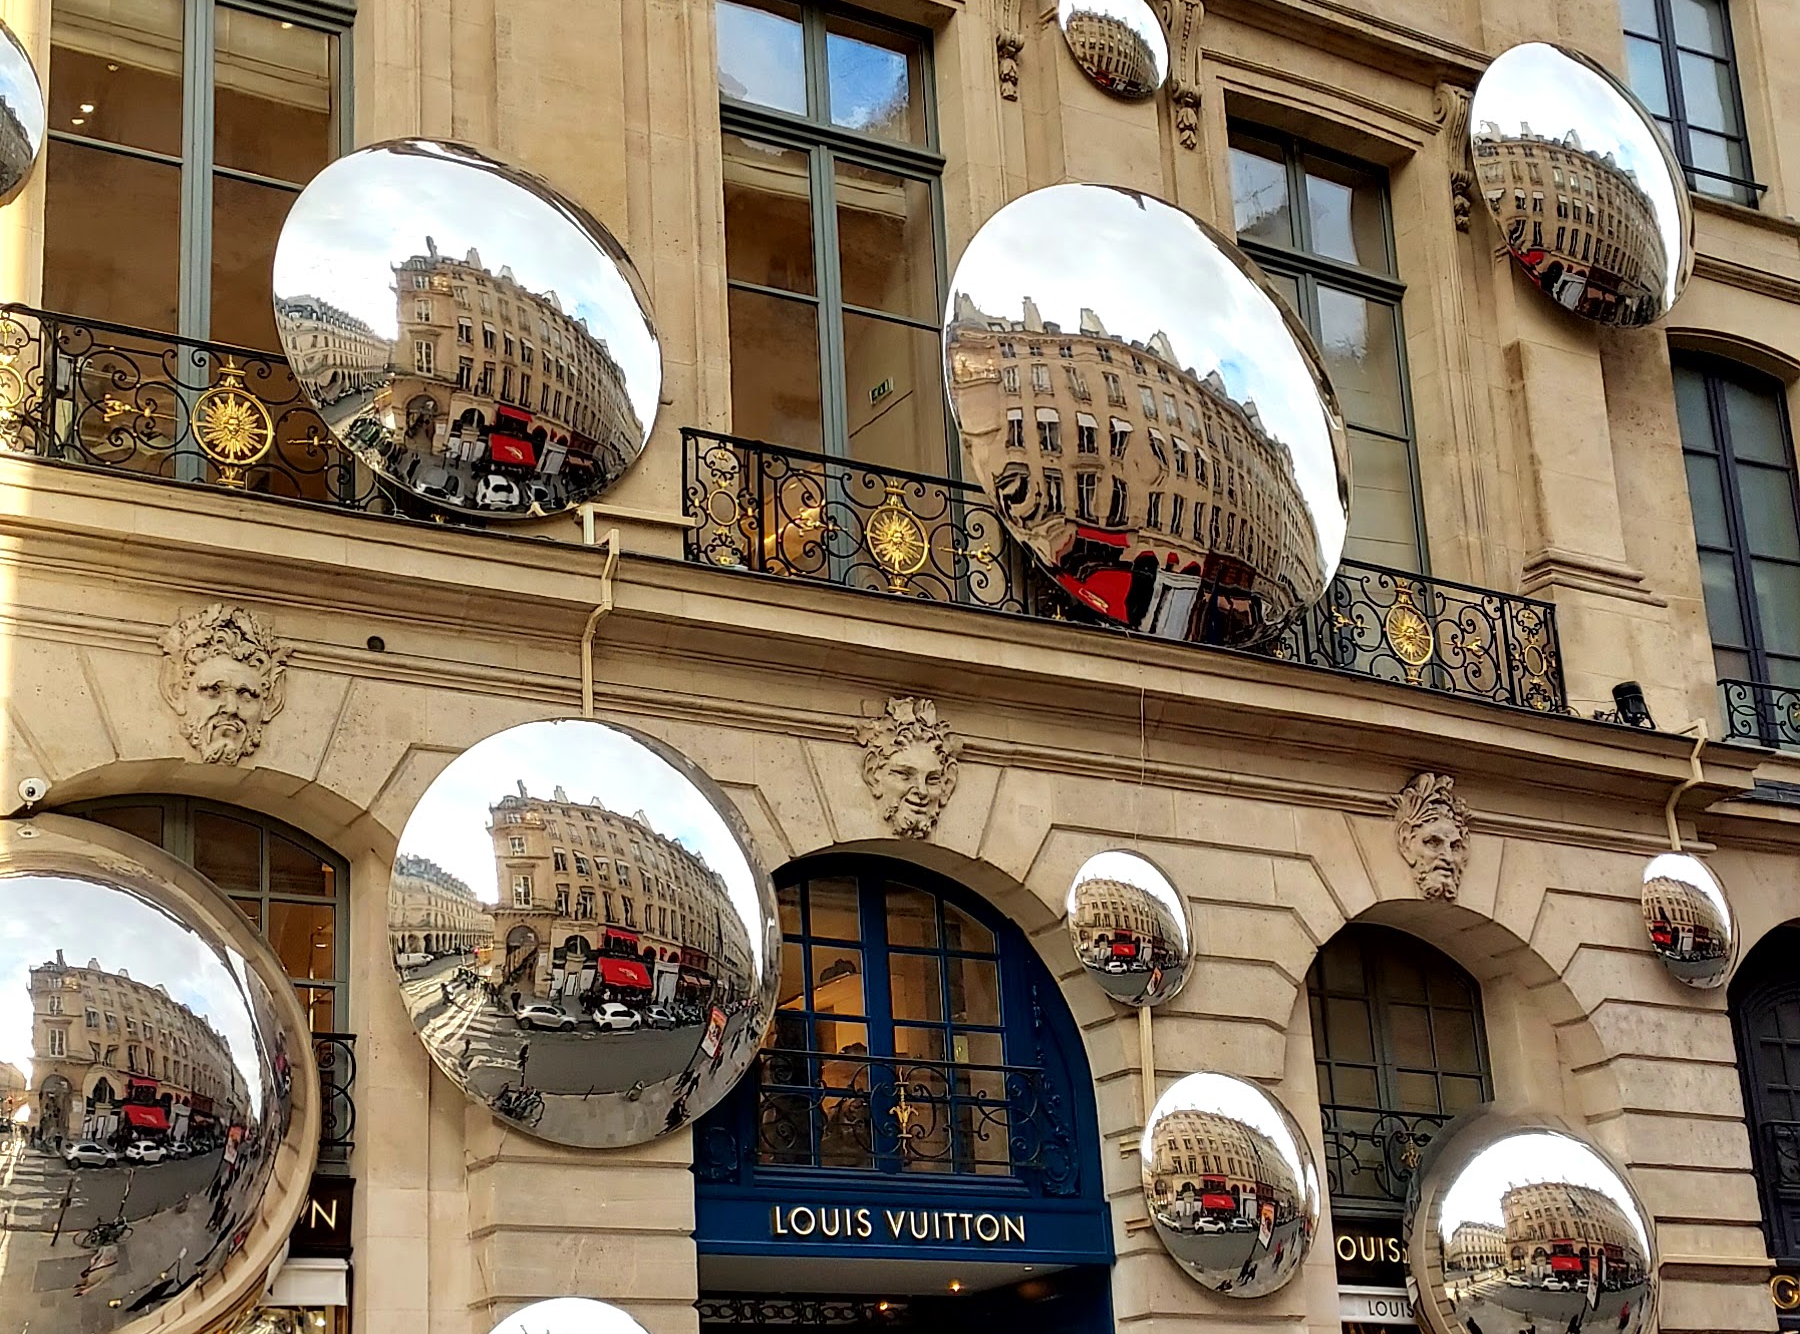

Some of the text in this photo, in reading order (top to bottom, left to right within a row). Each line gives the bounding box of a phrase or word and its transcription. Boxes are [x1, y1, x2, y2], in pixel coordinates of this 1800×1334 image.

[773, 1206, 1026, 1243] LOUIS VUITTON
[1367, 1299, 1415, 1319] LOUIS
